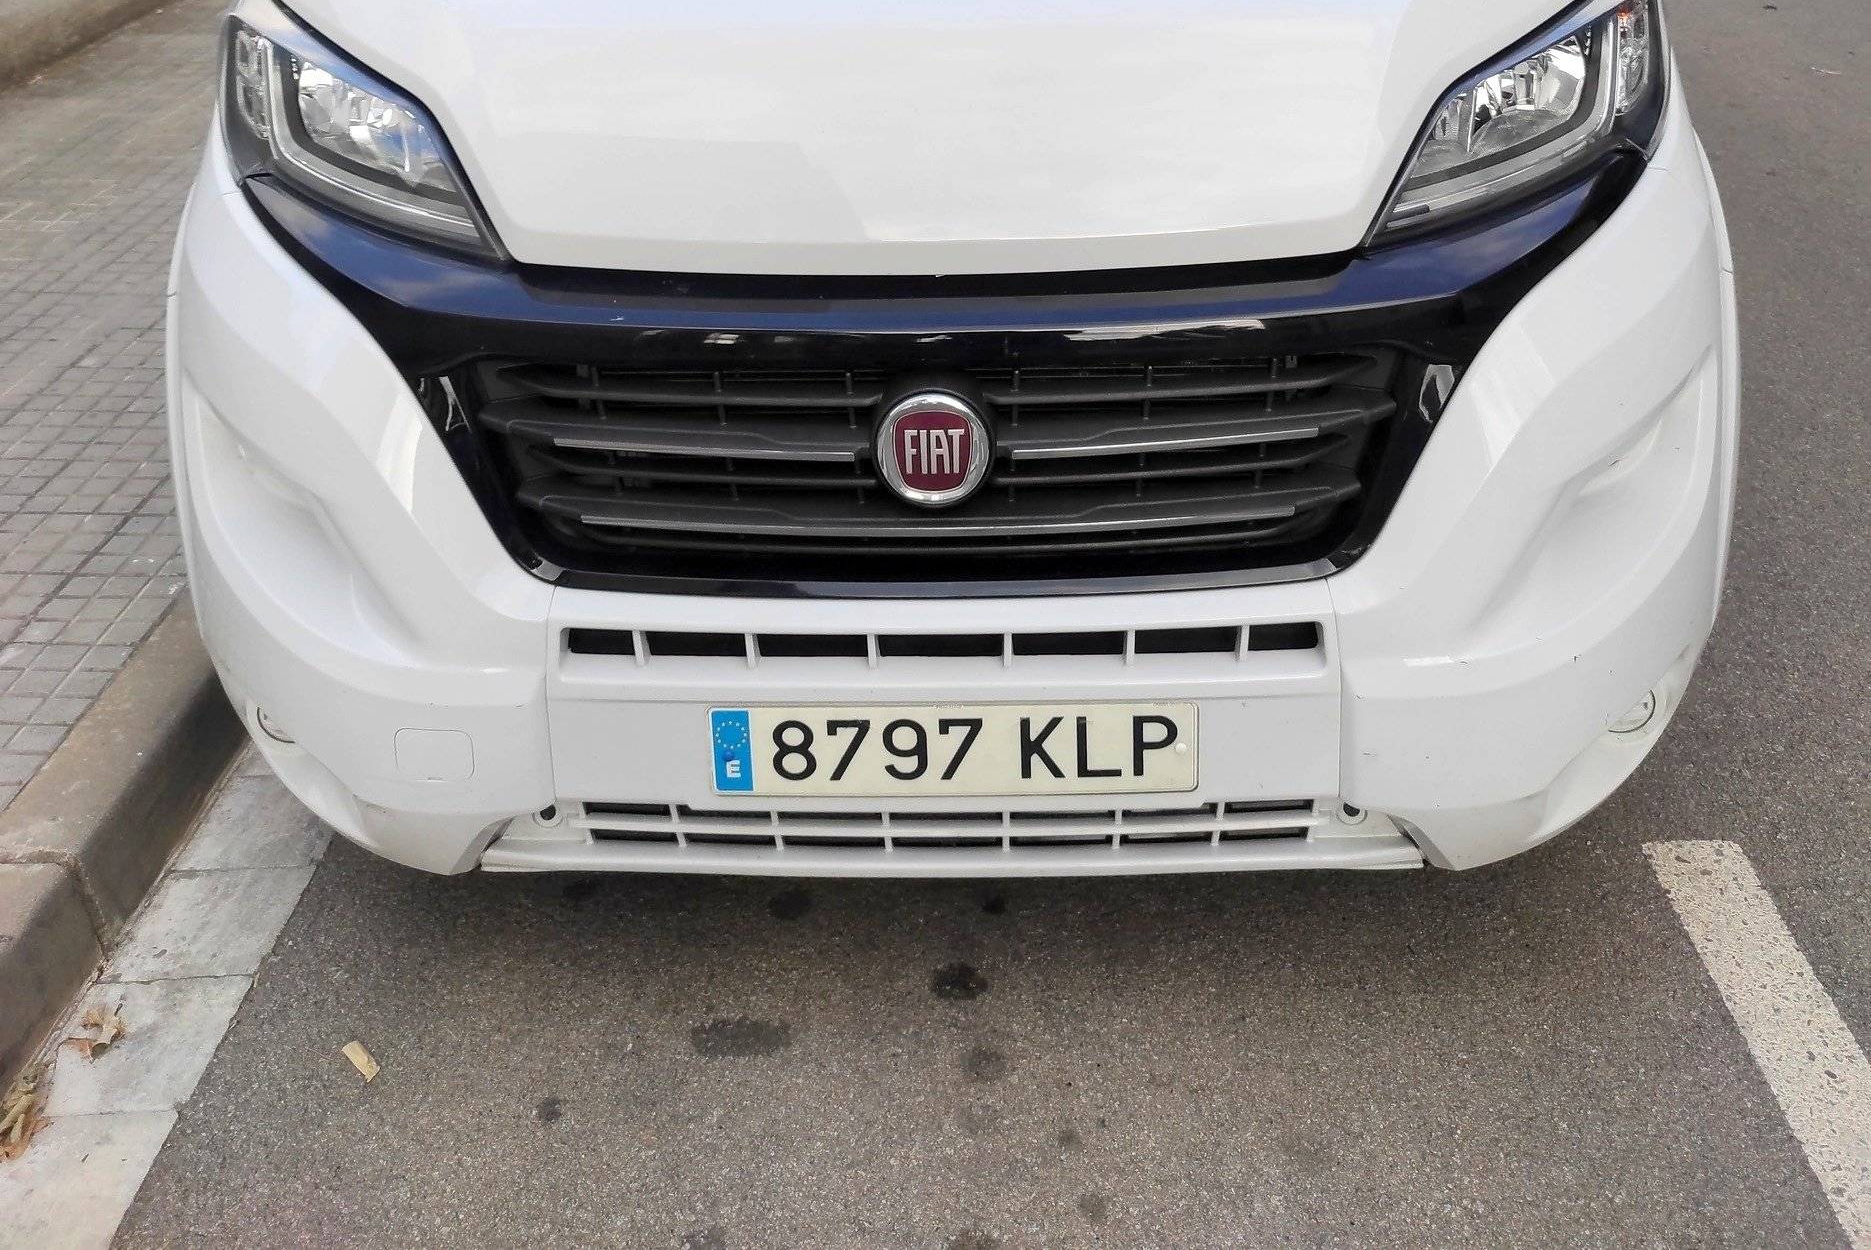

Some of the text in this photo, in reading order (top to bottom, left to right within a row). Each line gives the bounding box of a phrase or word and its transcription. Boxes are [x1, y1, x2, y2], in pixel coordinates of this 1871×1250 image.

[904, 429, 965, 475] FIAT
[725, 759, 742, 778] E
[771, 714, 1179, 782] 8797 KLP
